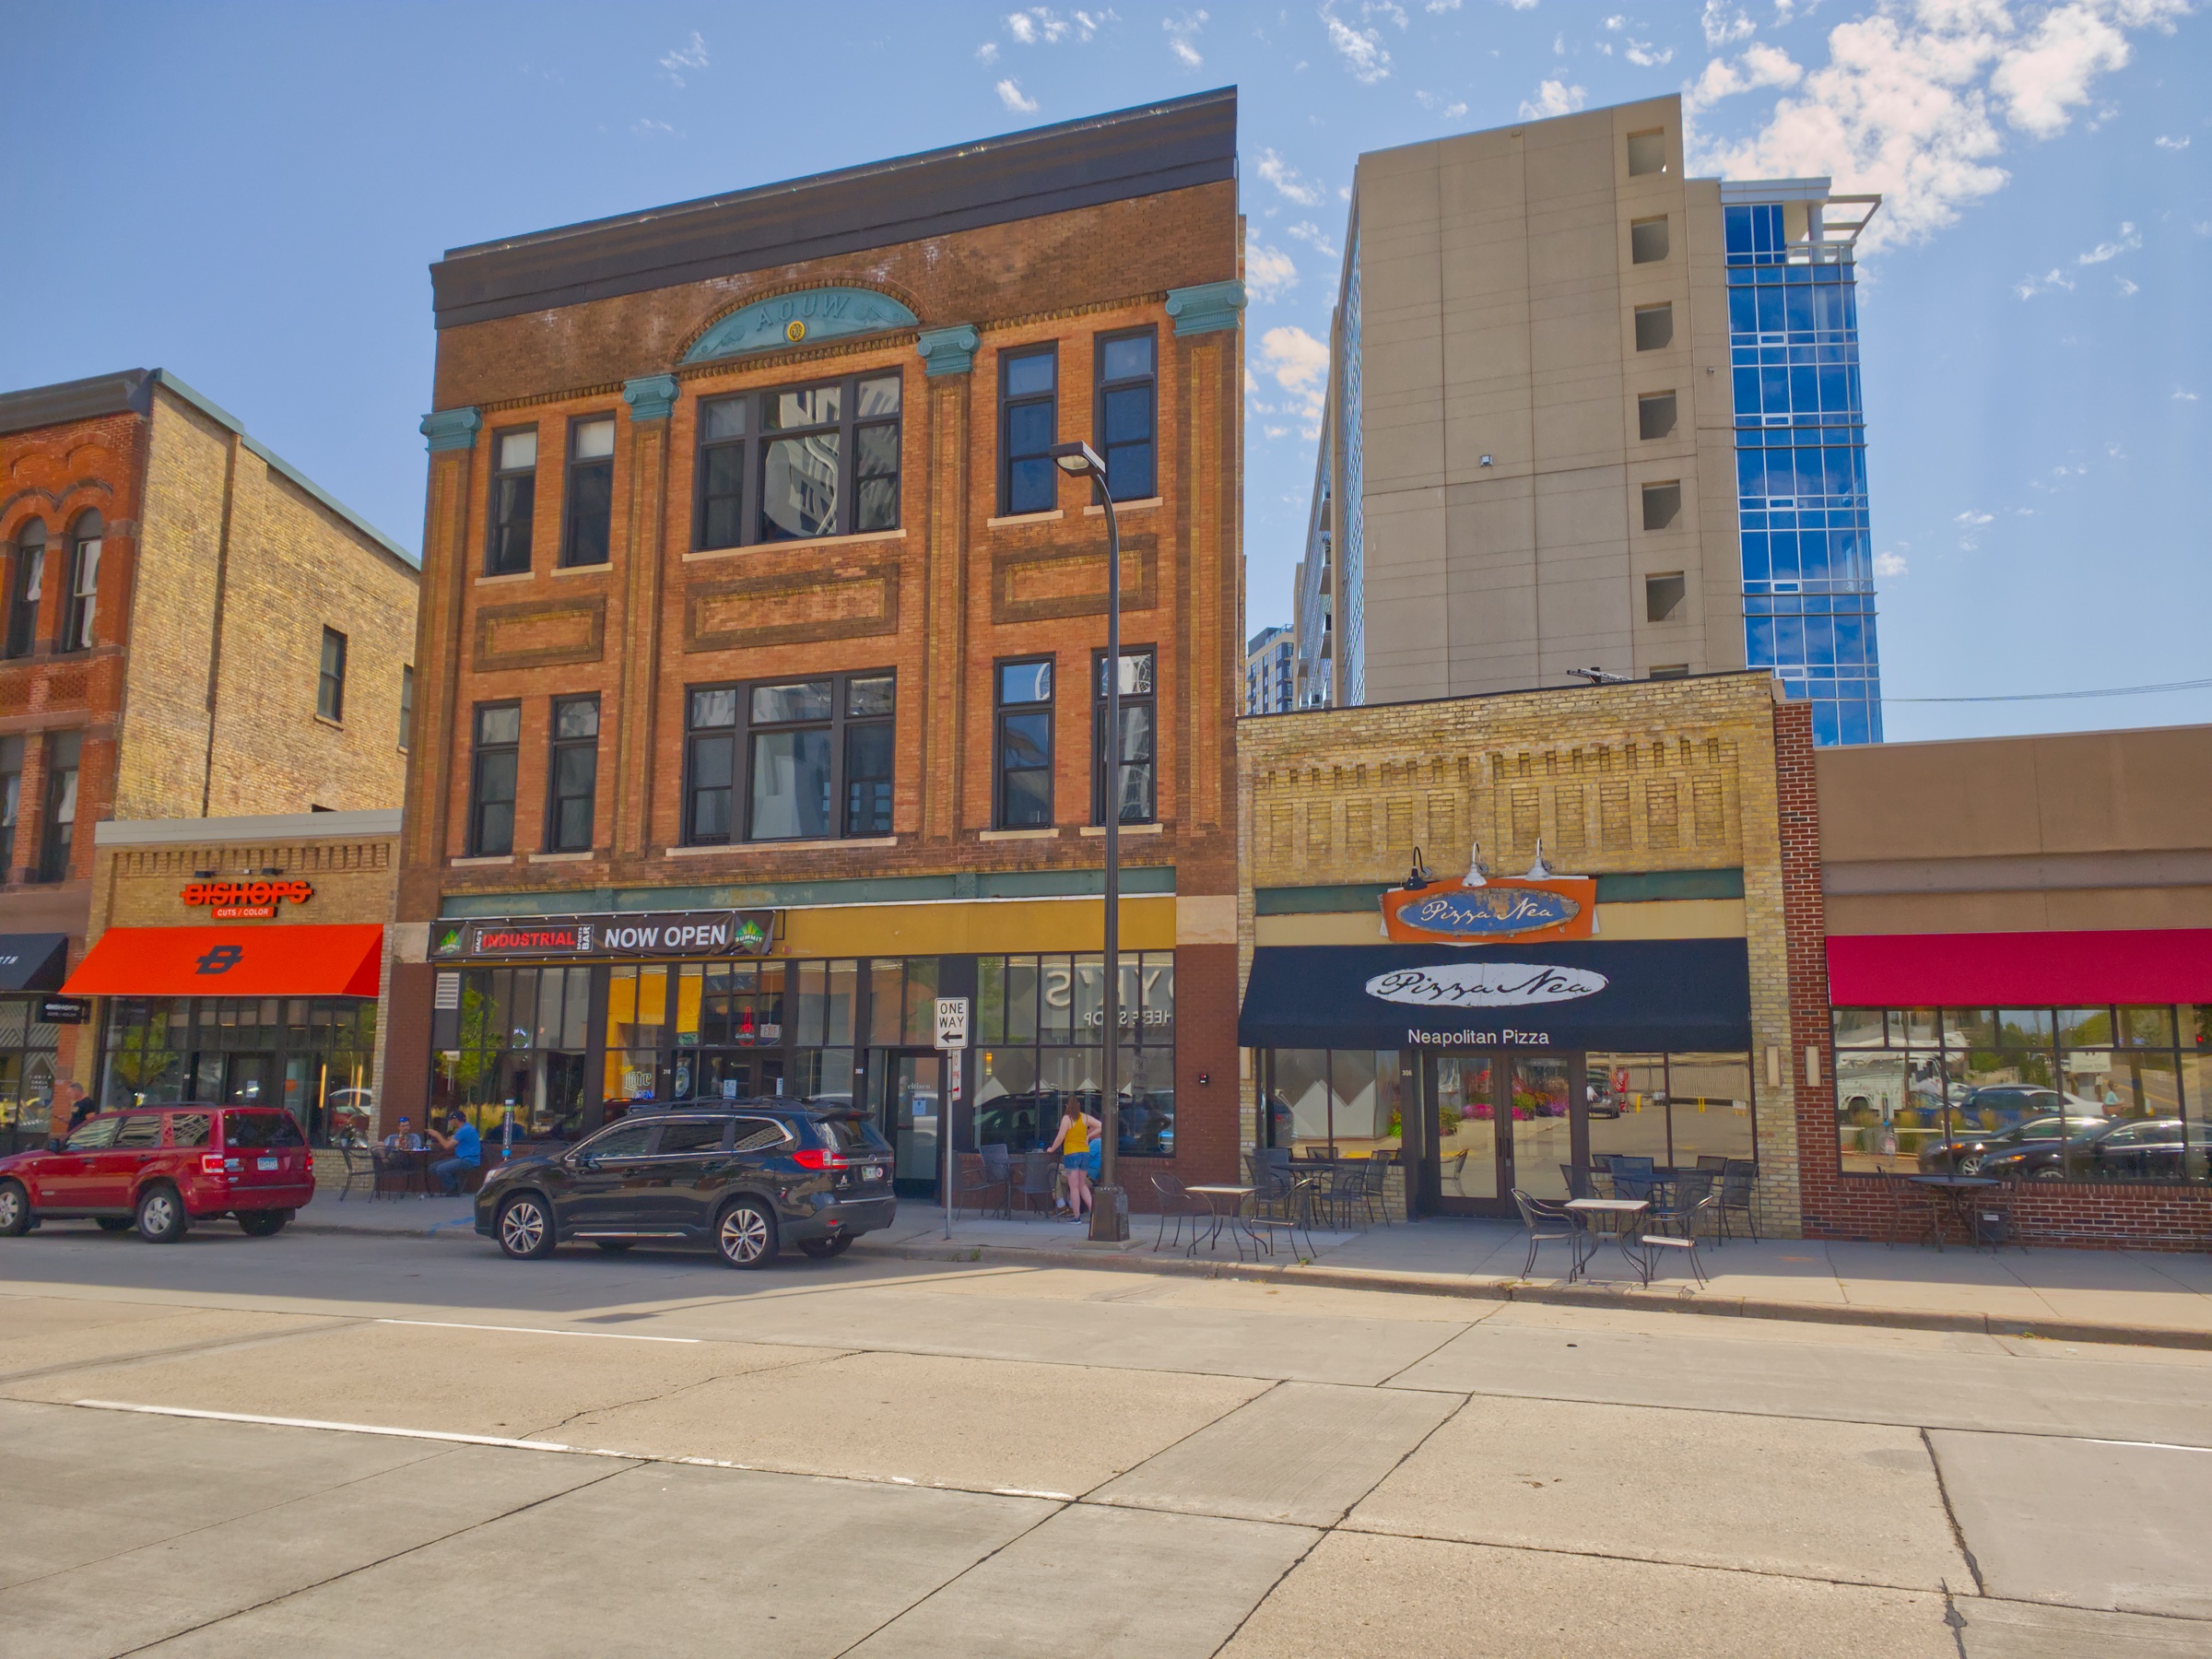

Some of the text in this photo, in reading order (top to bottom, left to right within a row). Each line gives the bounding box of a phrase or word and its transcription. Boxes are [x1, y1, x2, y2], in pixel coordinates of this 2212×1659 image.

[181, 880, 312, 906] BISHOPS
[217, 909, 237, 917] CUTS
[242, 908, 270, 917] COLOR
[1420, 897, 1554, 924] Pizza Nea
[482, 932, 575, 947] INDUSTRIAL
[582, 926, 591, 950] BAR
[605, 924, 726, 948] NOW OPEN
[735, 935, 763, 943] SUMMIT
[1376, 969, 1592, 1001] Pizza Nea
[940, 1003, 964, 1015] ONE
[939, 1017, 964, 1028] WAY
[764, 1026, 776, 1036] EXIT
[1408, 1029, 1550, 1047] Neapolitan Pizza
[625, 1071, 652, 1091] Lite
[632, 1089, 653, 1100] OPEN
